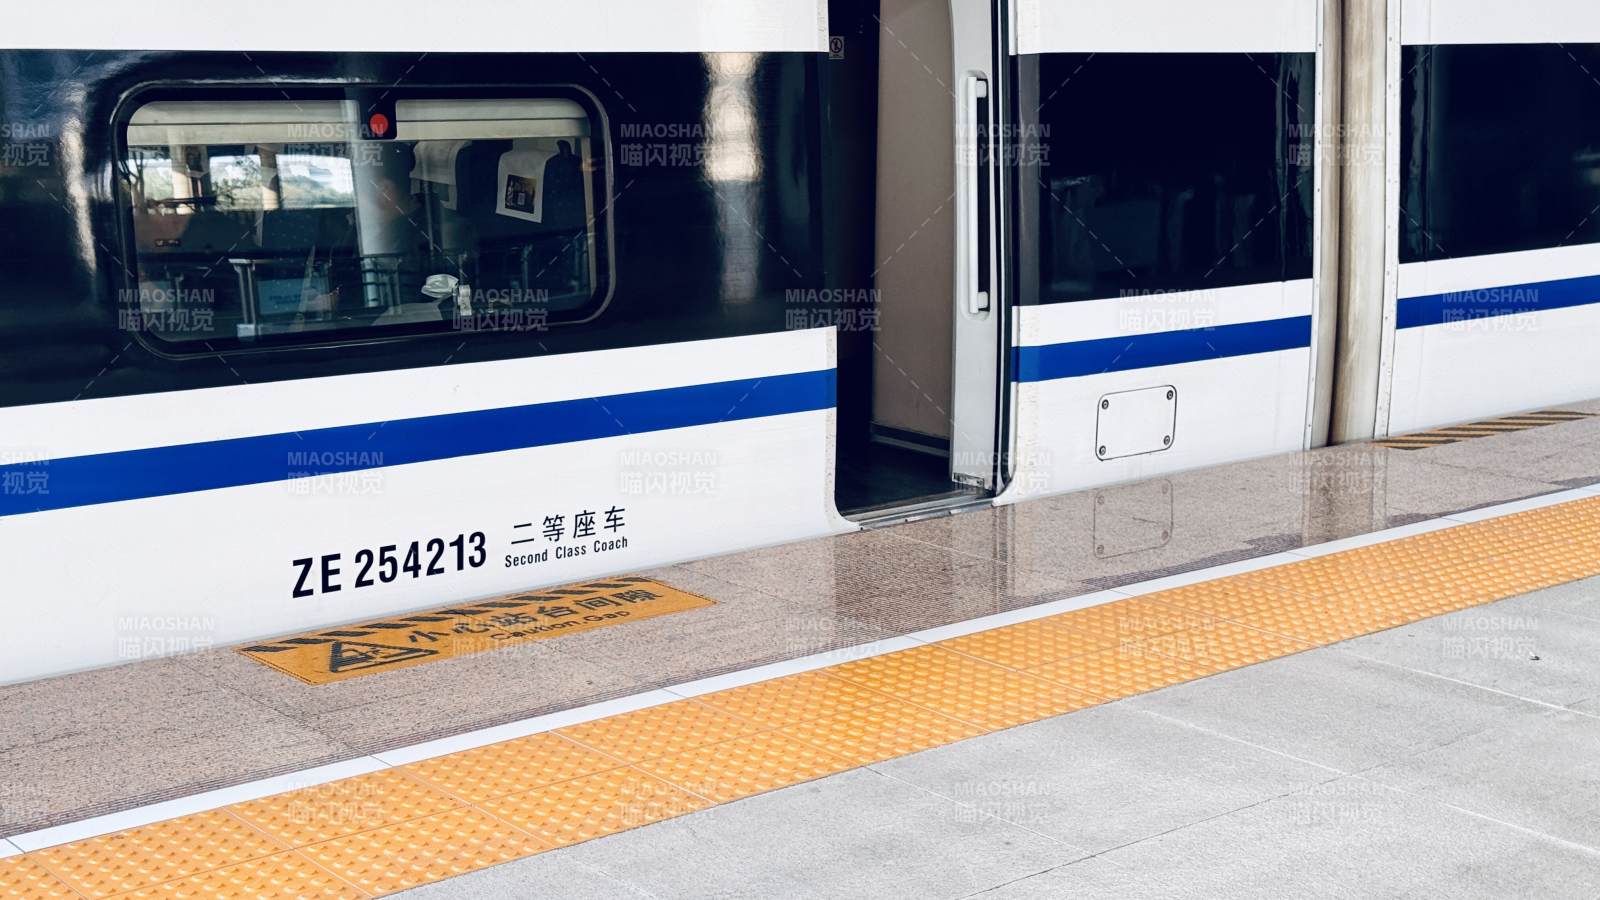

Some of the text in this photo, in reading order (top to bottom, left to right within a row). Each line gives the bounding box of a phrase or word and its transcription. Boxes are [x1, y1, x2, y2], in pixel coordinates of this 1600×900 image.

[511, 505, 626, 544] 二等座车
[292, 531, 487, 598] ZE 254213
[504, 536, 628, 568] Second Class Coach
[408, 589, 663, 643] 小心站台间隙
